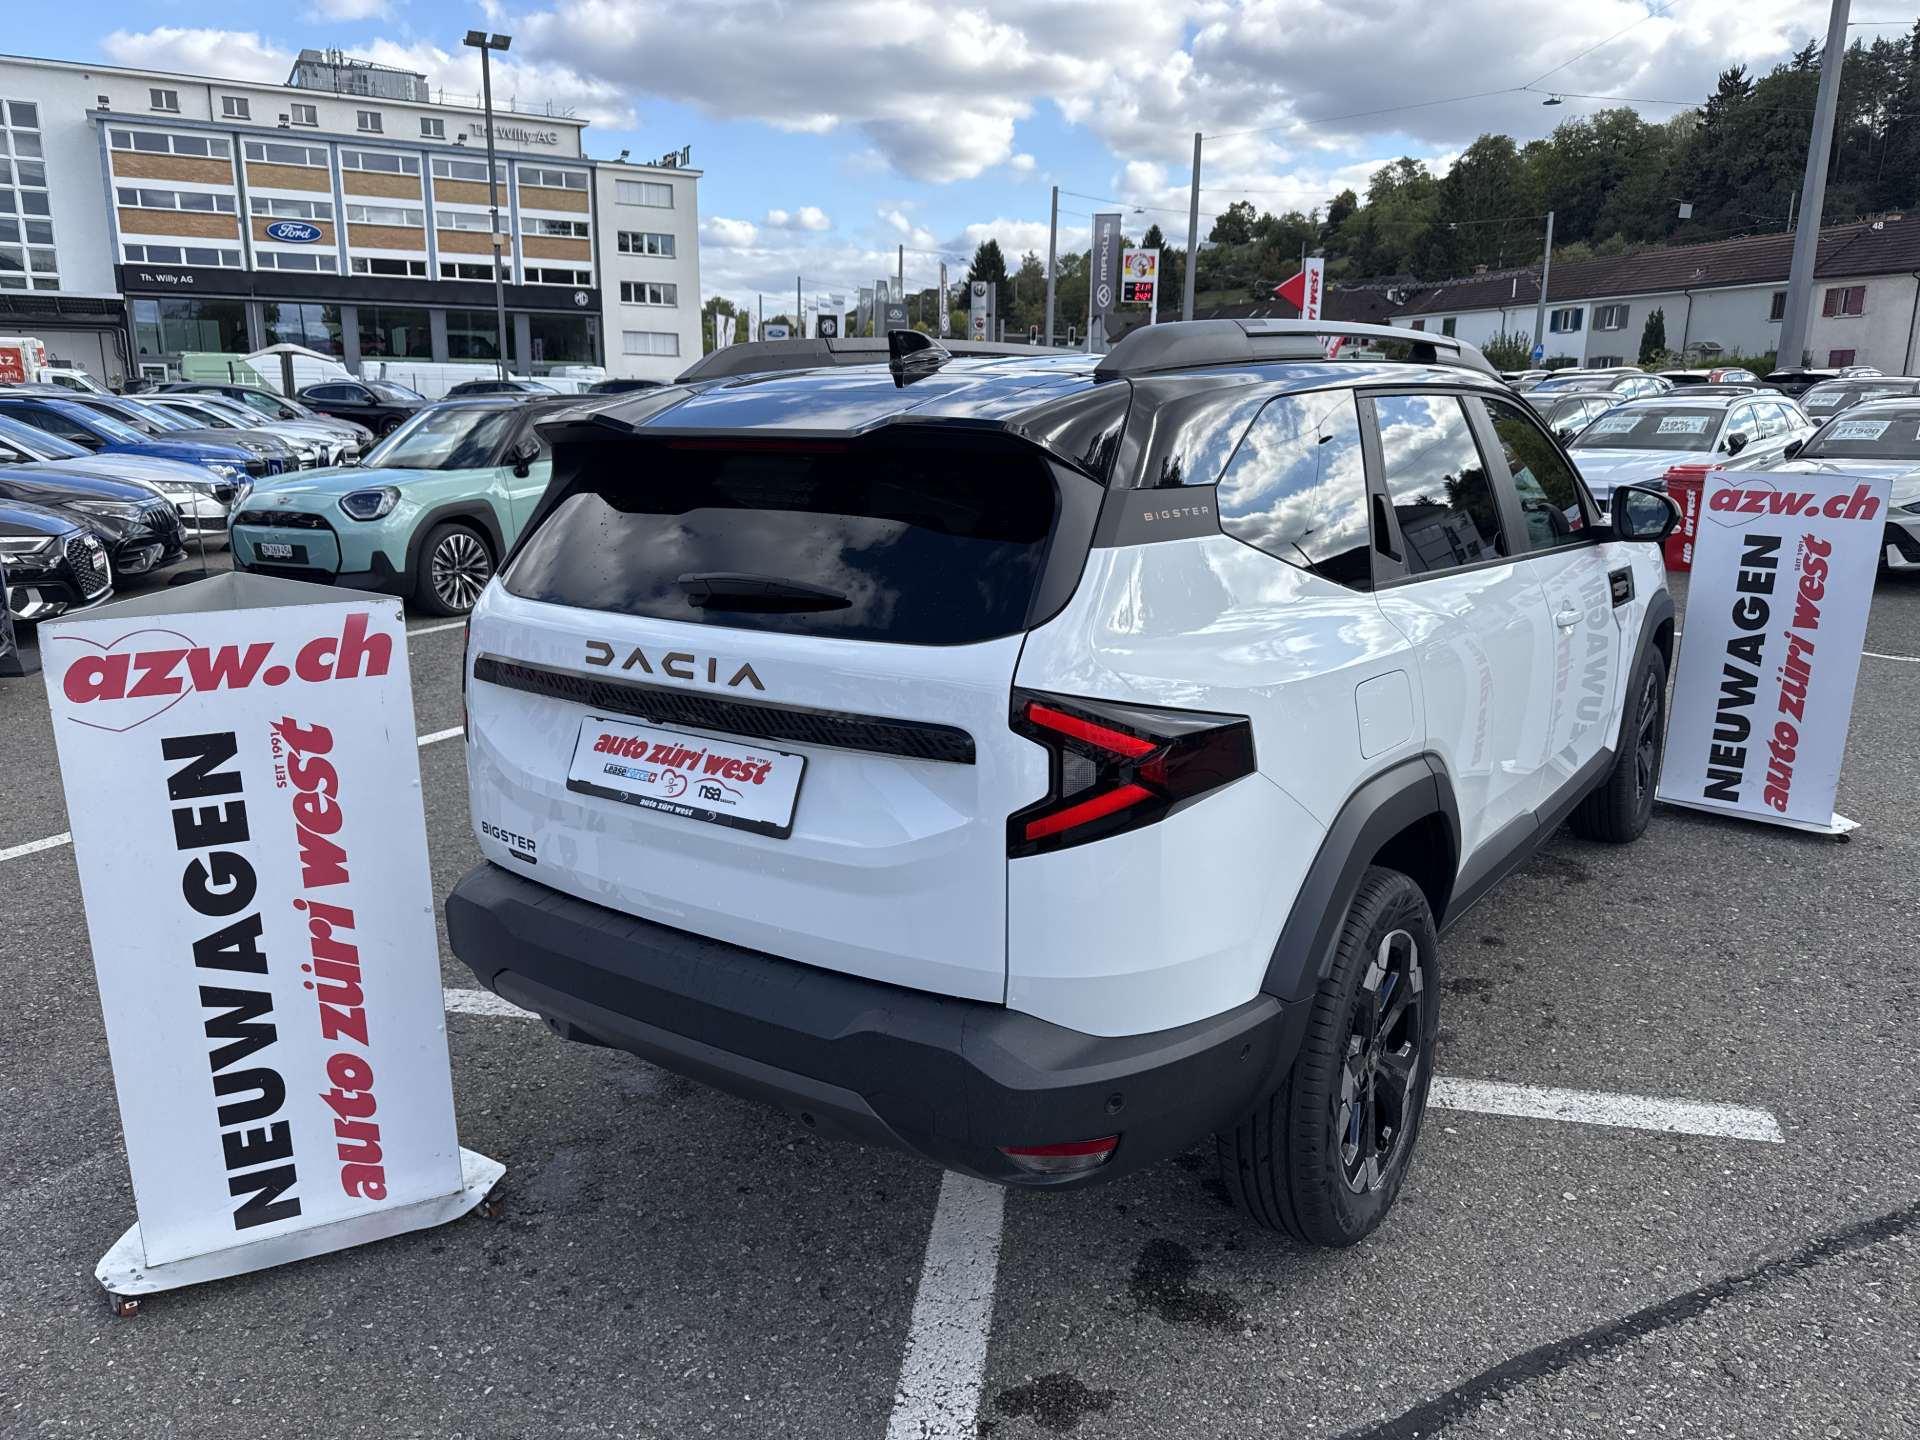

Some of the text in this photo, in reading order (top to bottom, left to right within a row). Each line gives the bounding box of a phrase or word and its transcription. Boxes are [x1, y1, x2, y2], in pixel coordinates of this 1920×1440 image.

[499, 127, 530, 145] Willy
[535, 129, 559, 146] AG
[278, 224, 311, 239] Ford
[1872, 221, 1884, 230] 48
[140, 273, 194, 285] Th. Willy AG
[1143, 506, 1209, 521] BIGSTER
[1709, 484, 1881, 520] azw.ch
[64, 614, 392, 702] azw.ch
[585, 640, 765, 691] DACIA
[1703, 534, 1782, 803] NEUWAGEN
[1763, 532, 1832, 813] auto züri west
[270, 732, 287, 788] SEIT 1991
[593, 733, 773, 785] auto züri west
[640, 799, 694, 816] auto züri west
[698, 785, 721, 801] nsa
[481, 820, 536, 853] BIGSTER
[270, 716, 387, 1201] auto züri west
[161, 731, 302, 1231] NEUWAGEN
